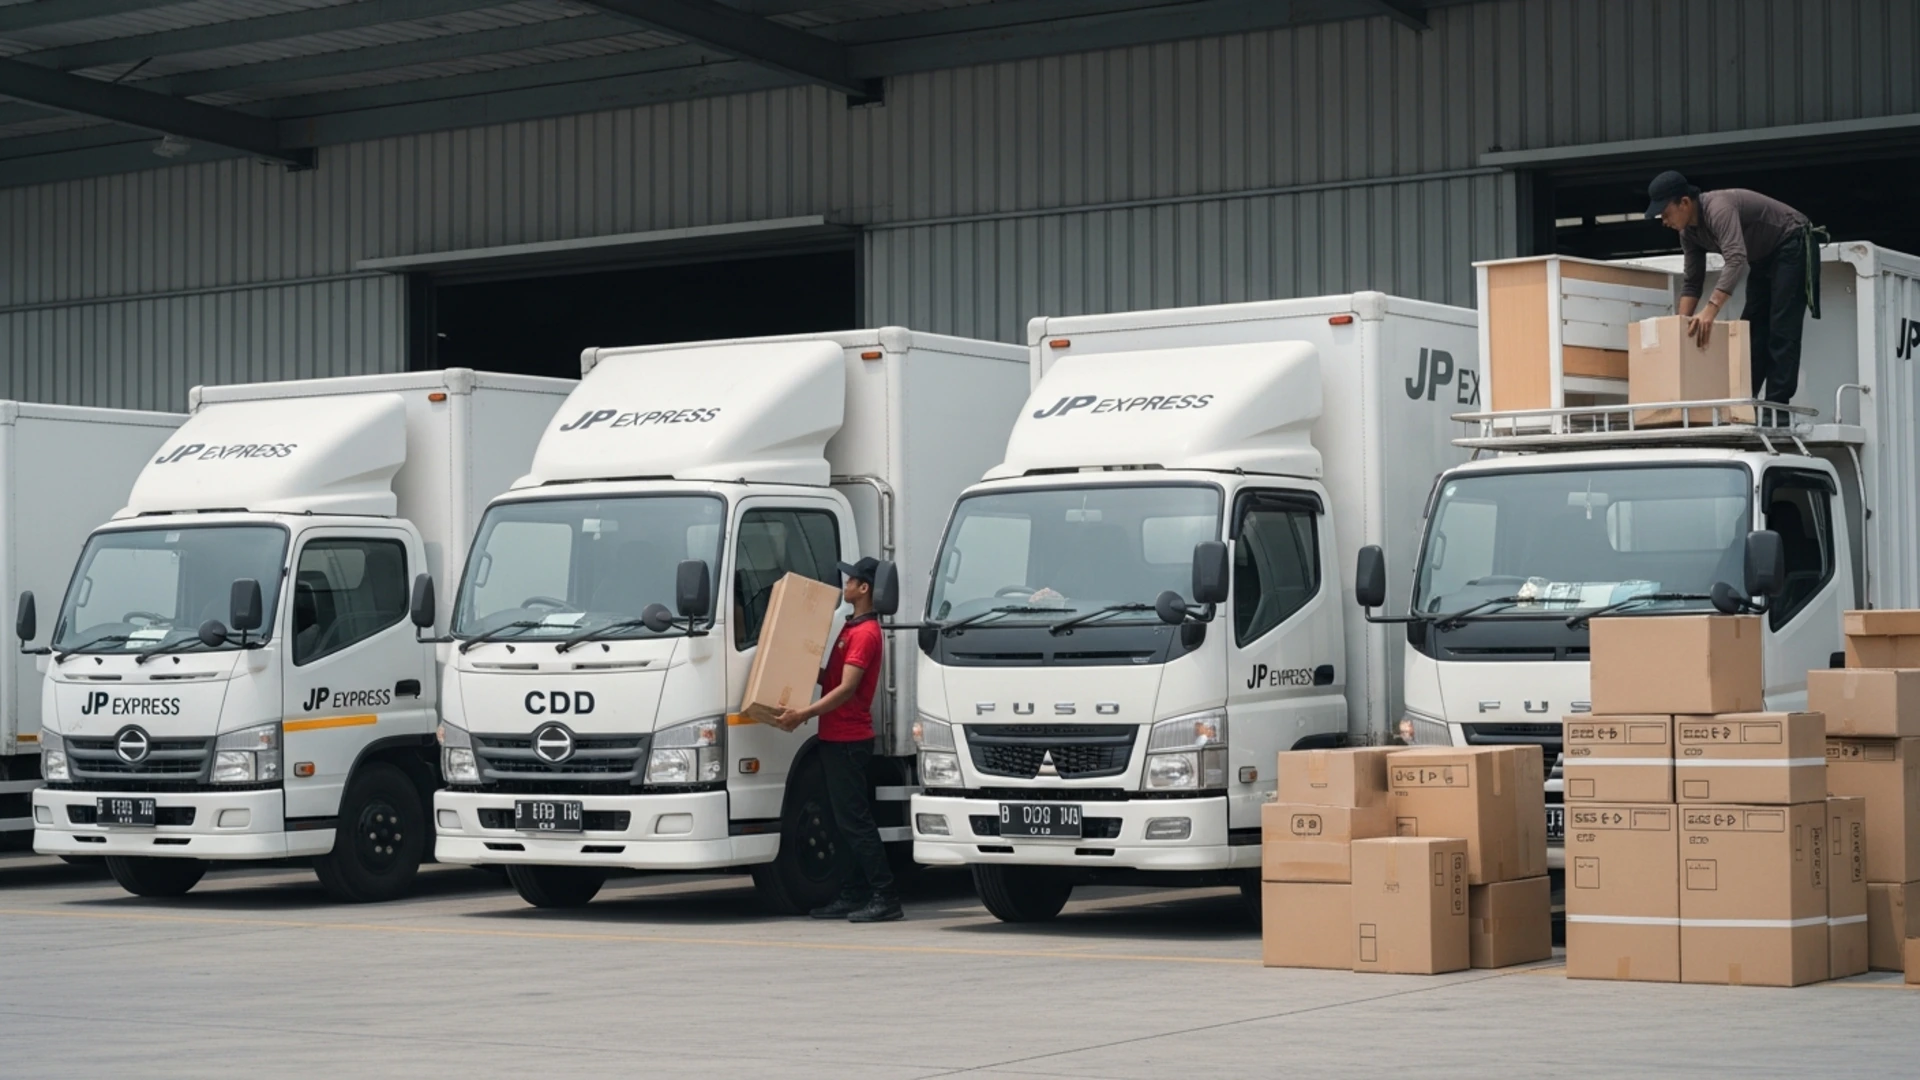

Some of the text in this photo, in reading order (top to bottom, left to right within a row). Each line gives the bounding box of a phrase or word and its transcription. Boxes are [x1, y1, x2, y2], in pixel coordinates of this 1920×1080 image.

[1405, 347, 1455, 401] JP
[1033, 394, 1214, 419] JP EXPRESS
[559, 407, 721, 432] JP EXPRESS
[155, 443, 206, 465] JP
[1247, 663, 1268, 689] JP
[81, 691, 181, 716] JP EXPRESS
[302, 687, 330, 711] JP
[524, 690, 596, 715] CDD
[976, 702, 1120, 715] FUSO
